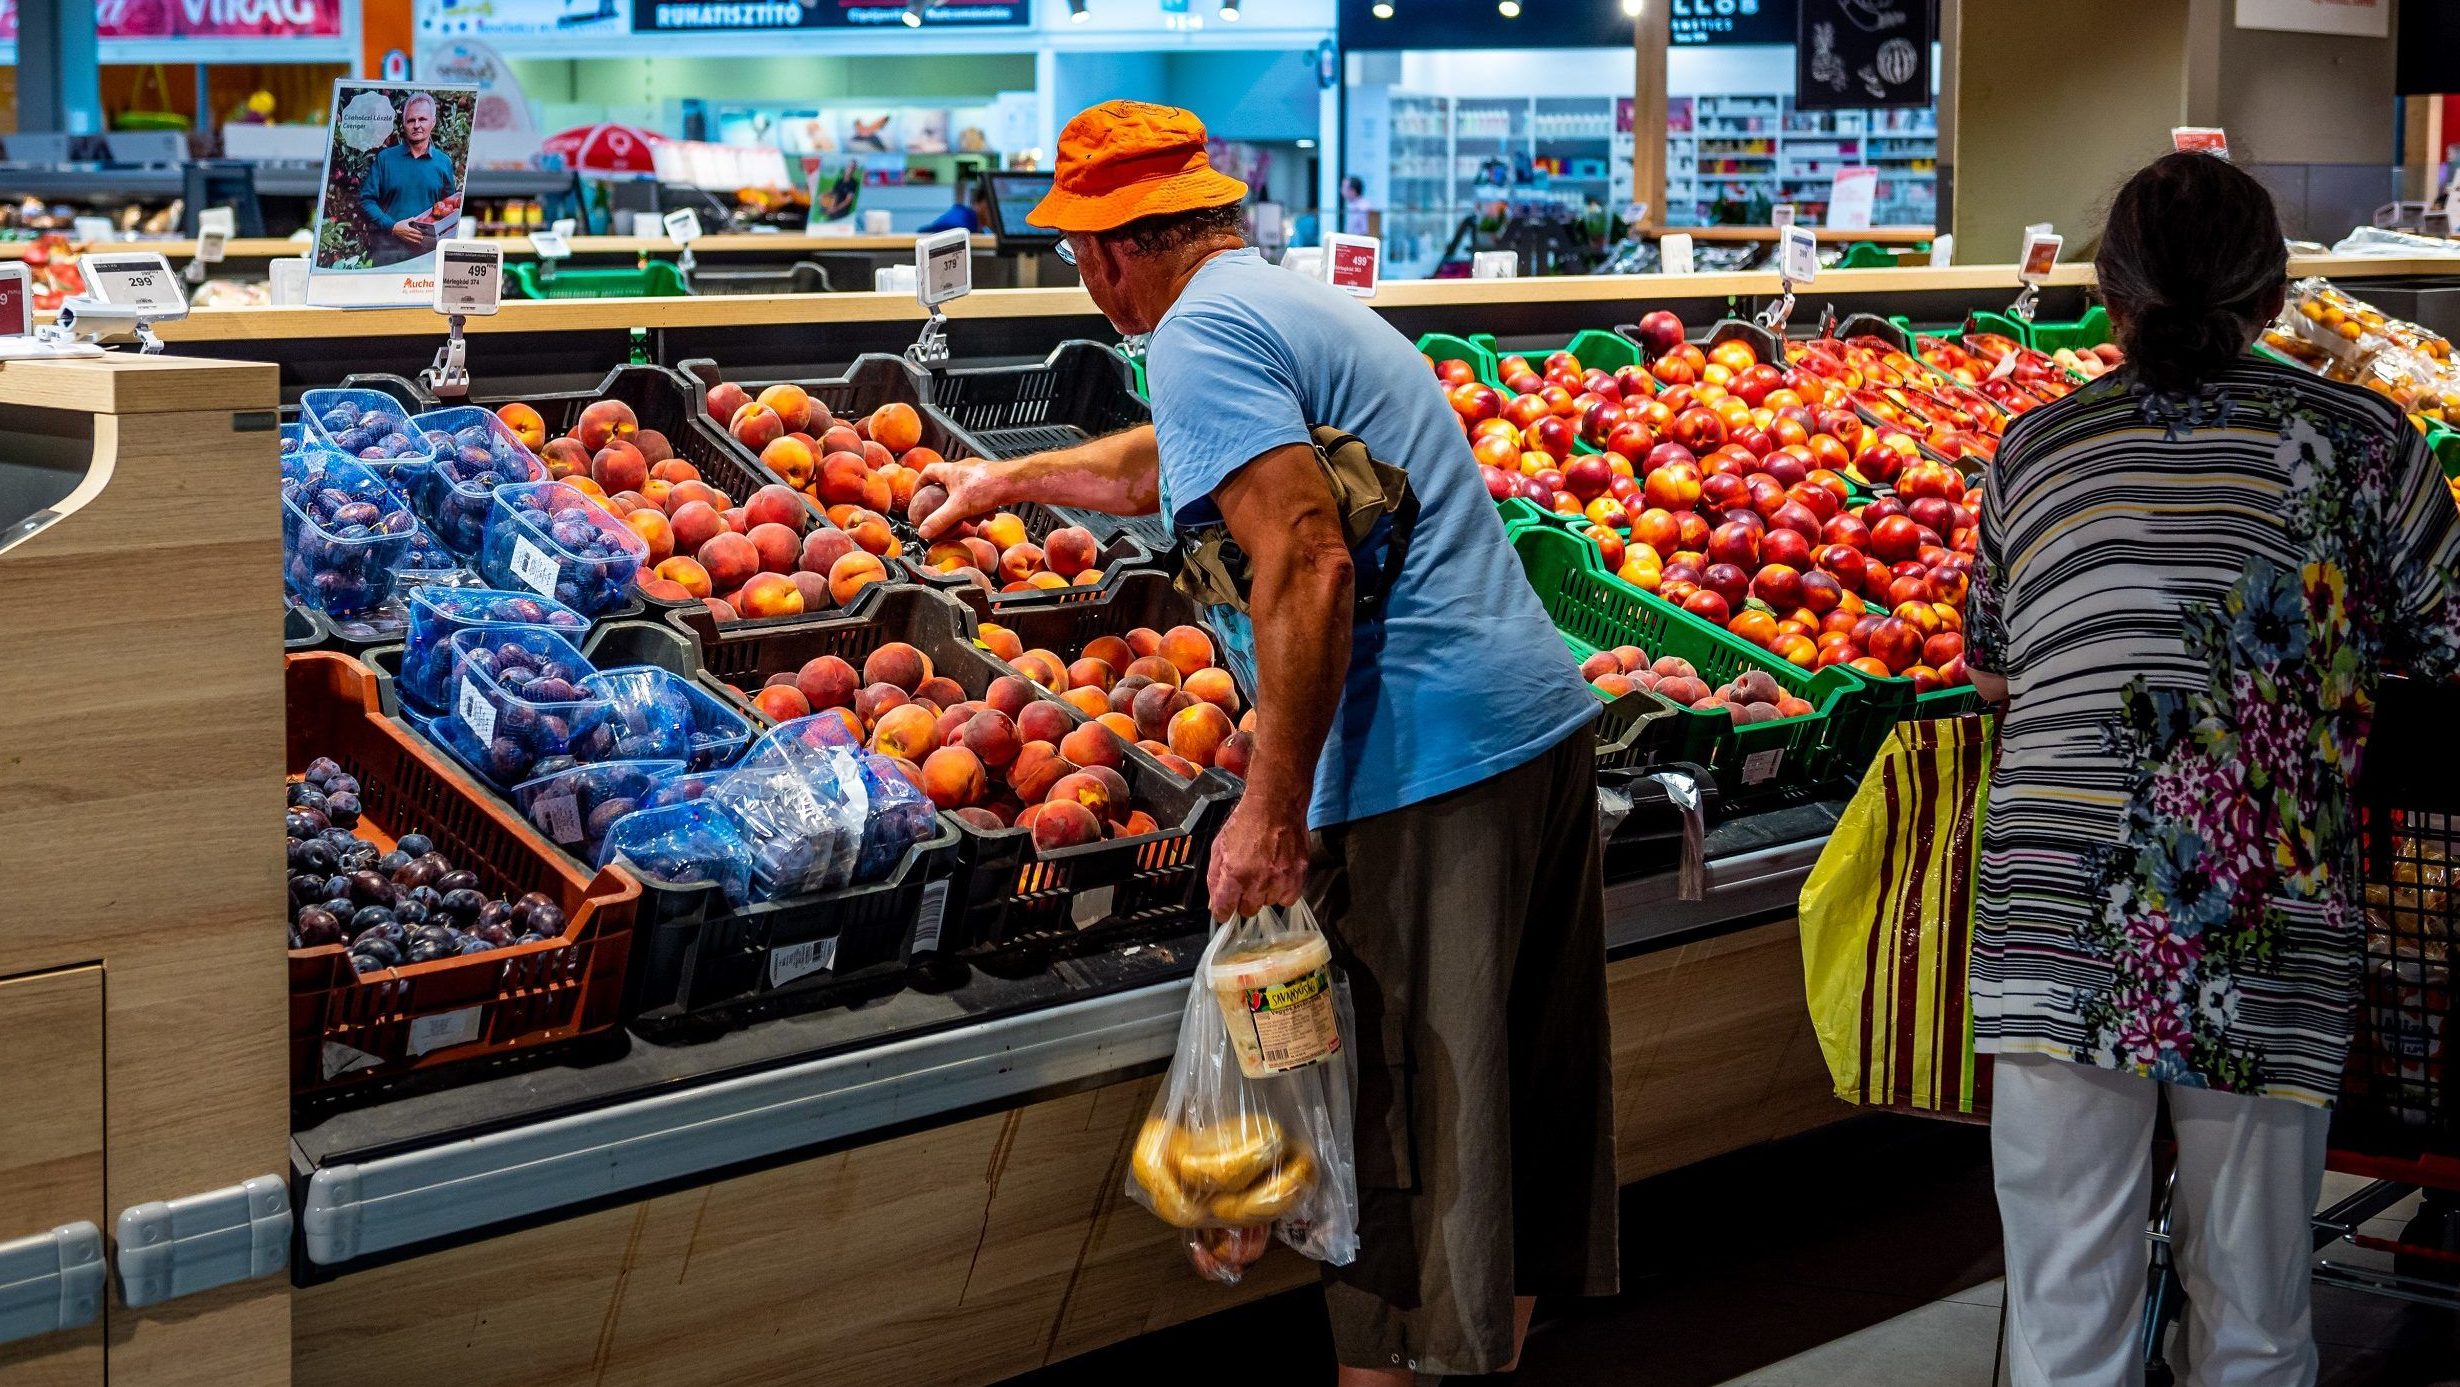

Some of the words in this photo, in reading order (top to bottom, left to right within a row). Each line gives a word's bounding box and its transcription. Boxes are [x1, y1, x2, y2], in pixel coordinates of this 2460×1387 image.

[943, 258, 957, 271] 379
[1353, 256, 1367, 266] 499
[468, 265, 487, 276] 499
[128, 277, 153, 287] 299
[404, 278, 434, 287] Aucha
